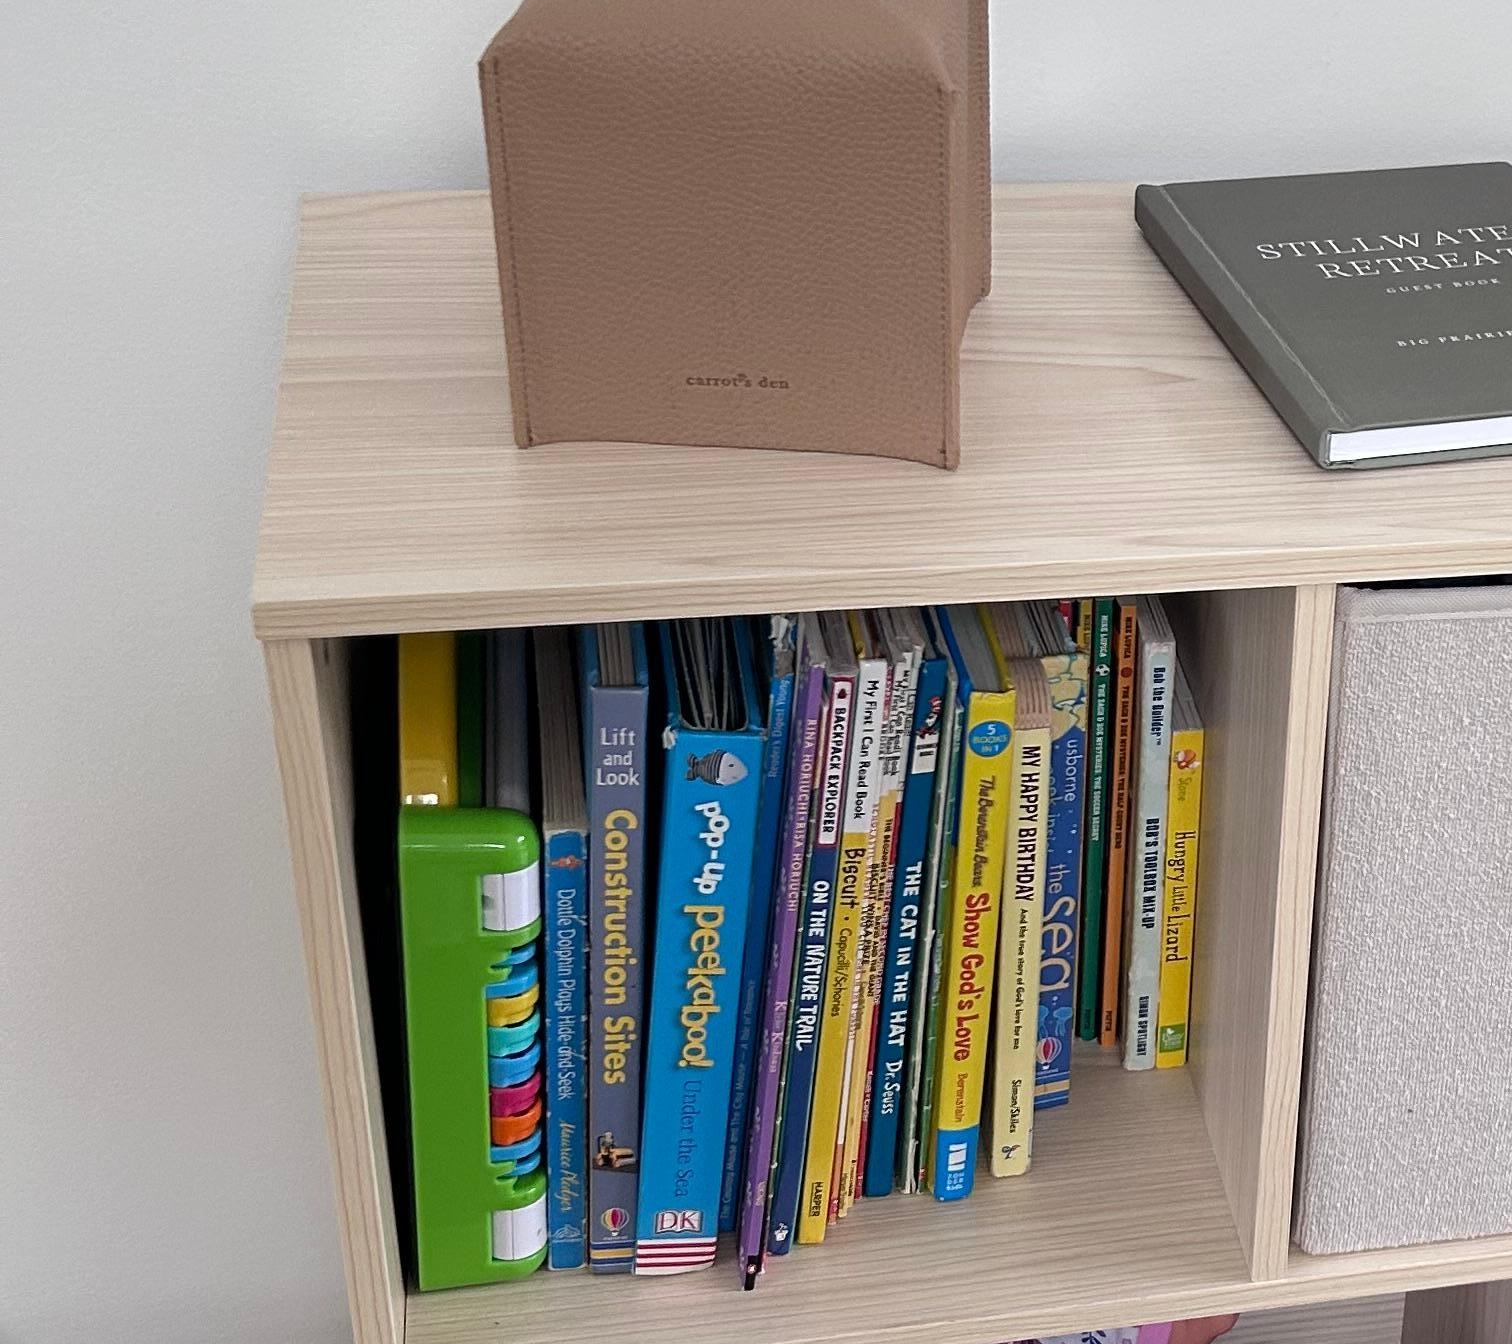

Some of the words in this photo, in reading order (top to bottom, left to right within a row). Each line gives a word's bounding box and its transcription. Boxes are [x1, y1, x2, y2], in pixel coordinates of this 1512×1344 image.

[1385, 282, 1443, 294] GUEST
[1453, 278, 1500, 288] BOOK
[1396, 337, 1430, 347] BIG
[686, 373, 752, 388] carrot's
[758, 376, 790, 389] den
[865, 678, 880, 697] My
[1153, 666, 1165, 683] Bob
[1153, 686, 1164, 701] the
[864, 699, 877, 725] First
[600, 728, 637, 746] Lift
[830, 706, 846, 770] BACKPACK
[986, 723, 996, 736] 5
[603, 750, 633, 766] and
[860, 735, 873, 758] Can
[994, 744, 999, 752] 1
[1023, 744, 1041, 767] MY
[595, 768, 640, 786] Look
[798, 753, 811, 815] HORIUCHI
[858, 759, 871, 788] Read
[981, 774, 995, 797] The
[1065, 739, 1081, 802] usborne
[824, 774, 839, 833] EXPLORER
[854, 790, 867, 820] Book
[1020, 770, 1040, 822] HAPPY
[692, 801, 730, 894] pop-up
[1146, 817, 1159, 847] BOB'S
[1016, 825, 1036, 902] BIRTHDAY
[1144, 850, 1157, 893] TOOLBOX
[1169, 828, 1195, 883] Hungry
[813, 879, 831, 904] ON
[844, 845, 865, 910] Biscuit
[903, 859, 922, 898] THE
[1049, 863, 1069, 894] the
[604, 809, 638, 1005] Construction
[1142, 895, 1156, 928] MIX-UP
[1170, 885, 1189, 912] Little
[809, 906, 827, 938] THE
[899, 901, 918, 940] CAT
[963, 890, 993, 949] Show
[1020, 925, 1028, 938] the
[1021, 908, 1029, 924] And
[556, 928, 576, 976] Dolphin
[1165, 912, 1190, 964] Lizard
[897, 944, 912, 966] IN
[678, 904, 726, 1067] peekaboo!
[802, 942, 825, 1002] NATURE
[893, 969, 909, 1003] THE
[958, 951, 987, 1013] God's
[1017, 977, 1024, 985] of
[555, 978, 576, 1012] Plays
[1015, 987, 1025, 1008] God's
[794, 1002, 817, 1052] TRAIL
[889, 1008, 907, 1047] HAT
[954, 1014, 979, 1063] Love
[557, 1015, 576, 1100] Hide-and-Seek
[603, 1016, 637, 1084] Sites
[884, 1057, 902, 1081] Dr.
[681, 1078, 703, 1134] Under
[881, 1081, 899, 1115] Seuss
[955, 1072, 969, 1124] Berenstain
[678, 1137, 697, 1164] the
[676, 1167, 694, 1198] Sea
[811, 1181, 824, 1217] HARPER
[660, 1211, 697, 1230] DK
